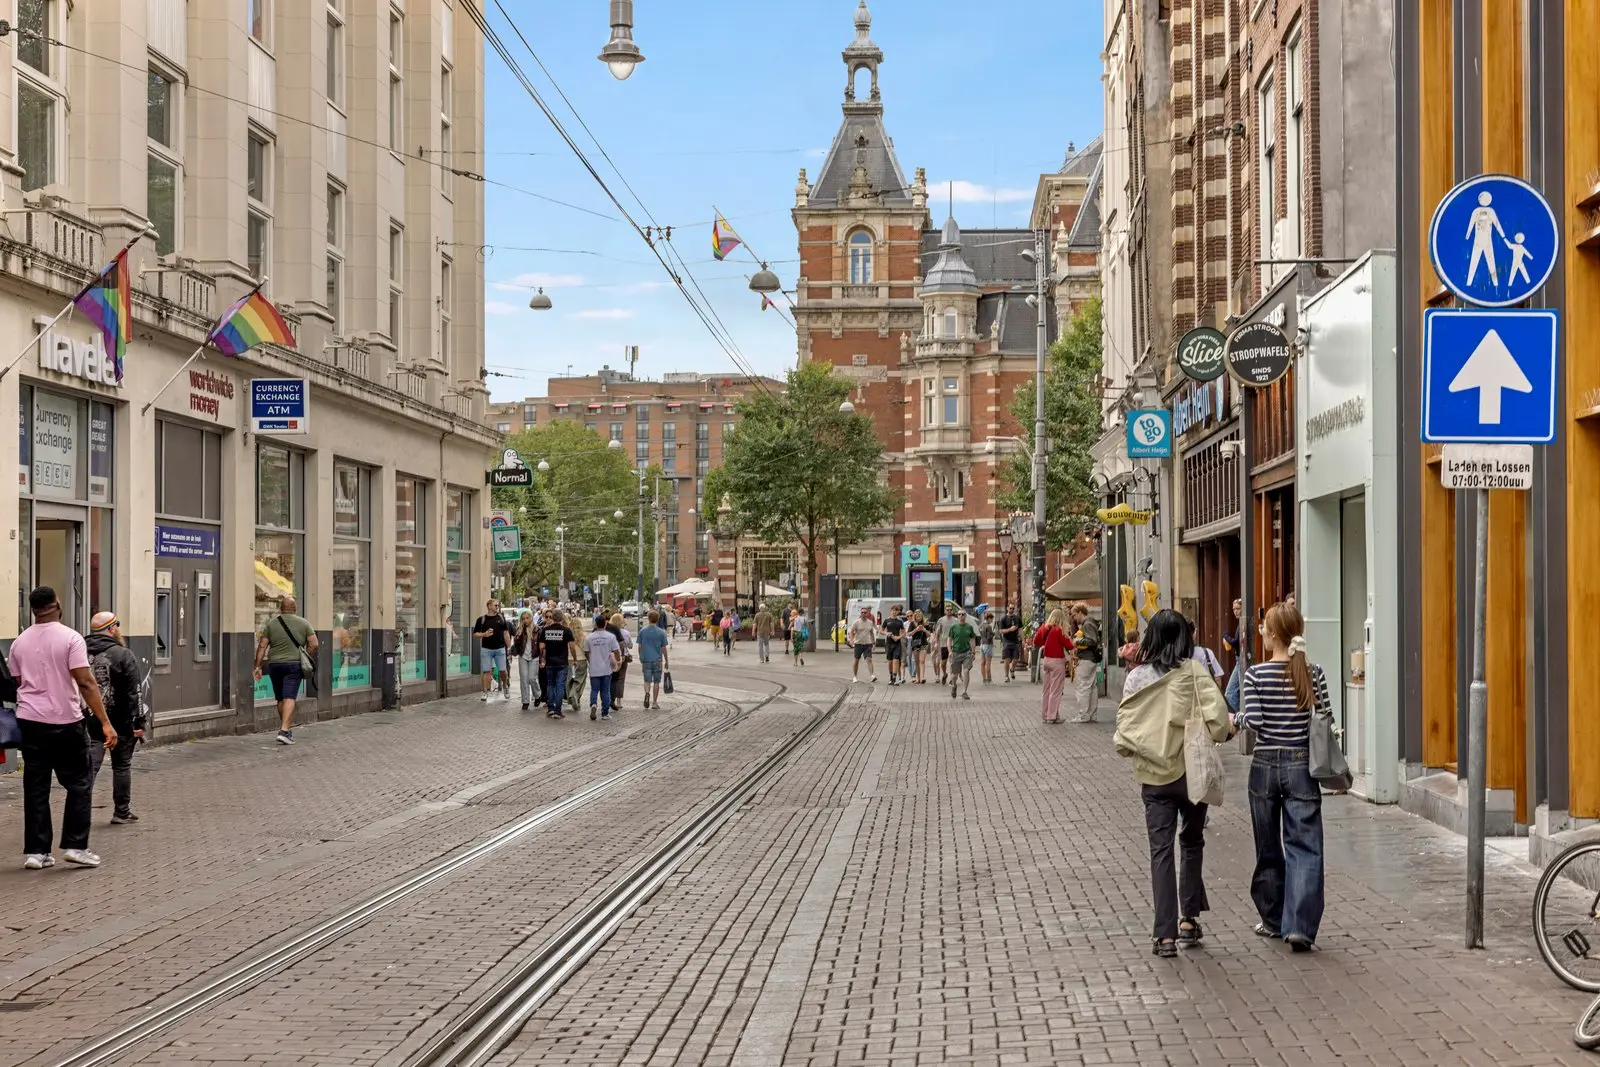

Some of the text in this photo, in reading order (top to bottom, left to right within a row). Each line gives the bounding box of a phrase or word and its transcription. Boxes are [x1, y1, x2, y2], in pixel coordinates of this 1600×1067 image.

[1234, 323, 1280, 343] FIRMA STROOP
[33, 313, 123, 389] Travele
[1180, 340, 1224, 366] Slice
[1230, 346, 1289, 363] STROOPWAFELS
[1251, 367, 1272, 375] SINDS
[189, 369, 234, 400] worldwide
[190, 393, 219, 421] money
[267, 406, 290, 414] ATM
[1139, 418, 1155, 430] to
[1144, 426, 1161, 443] go
[1151, 447, 1168, 455] Heijn
[1481, 463, 1493, 472] en
[1496, 460, 1530, 472] Lossen
[495, 472, 528, 482] Normal
[1107, 511, 1149, 521] souvenirs
